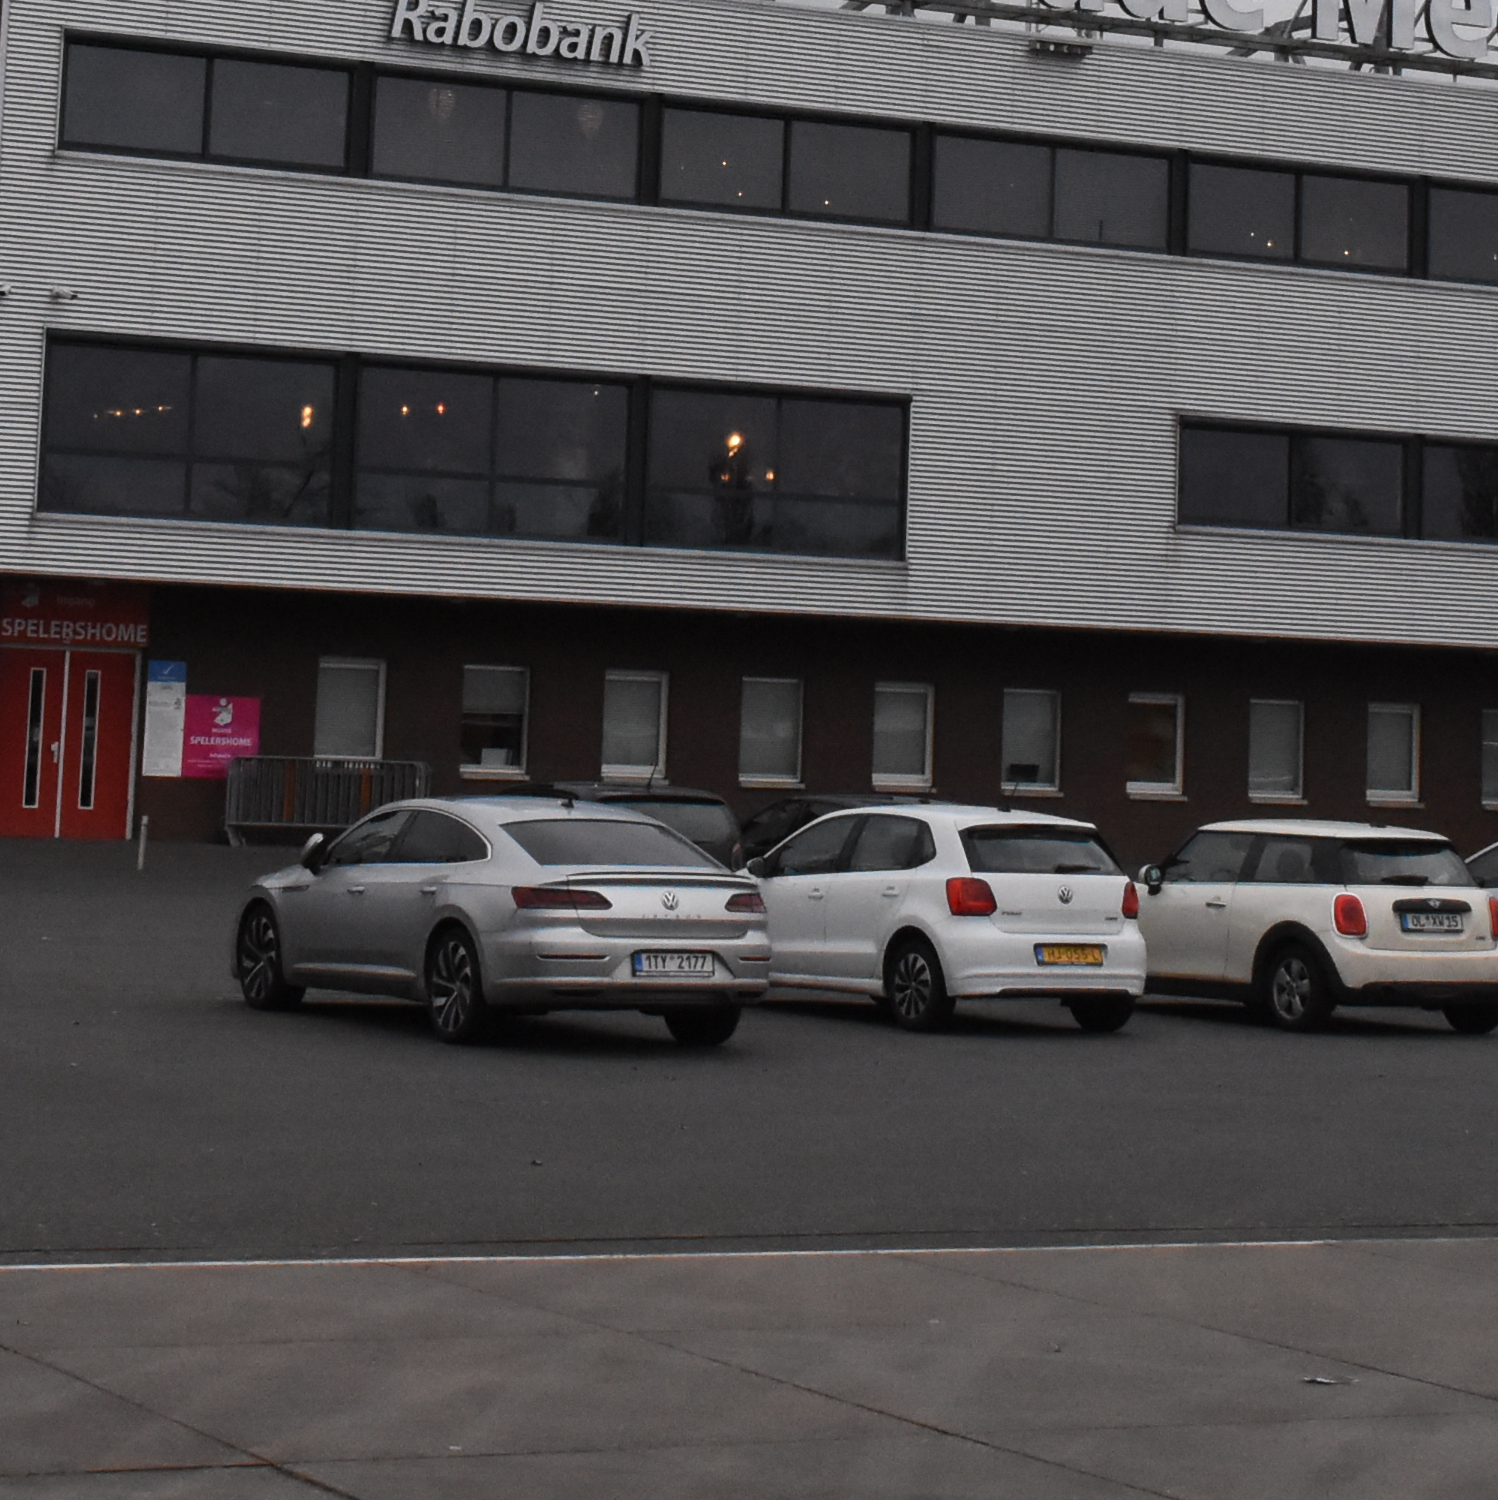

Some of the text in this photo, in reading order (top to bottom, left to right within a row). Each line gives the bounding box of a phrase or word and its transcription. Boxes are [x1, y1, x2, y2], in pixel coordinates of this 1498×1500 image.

[1, 618, 148, 643] SPELERSHOME
[645, 954, 707, 970] 1TY 2177
